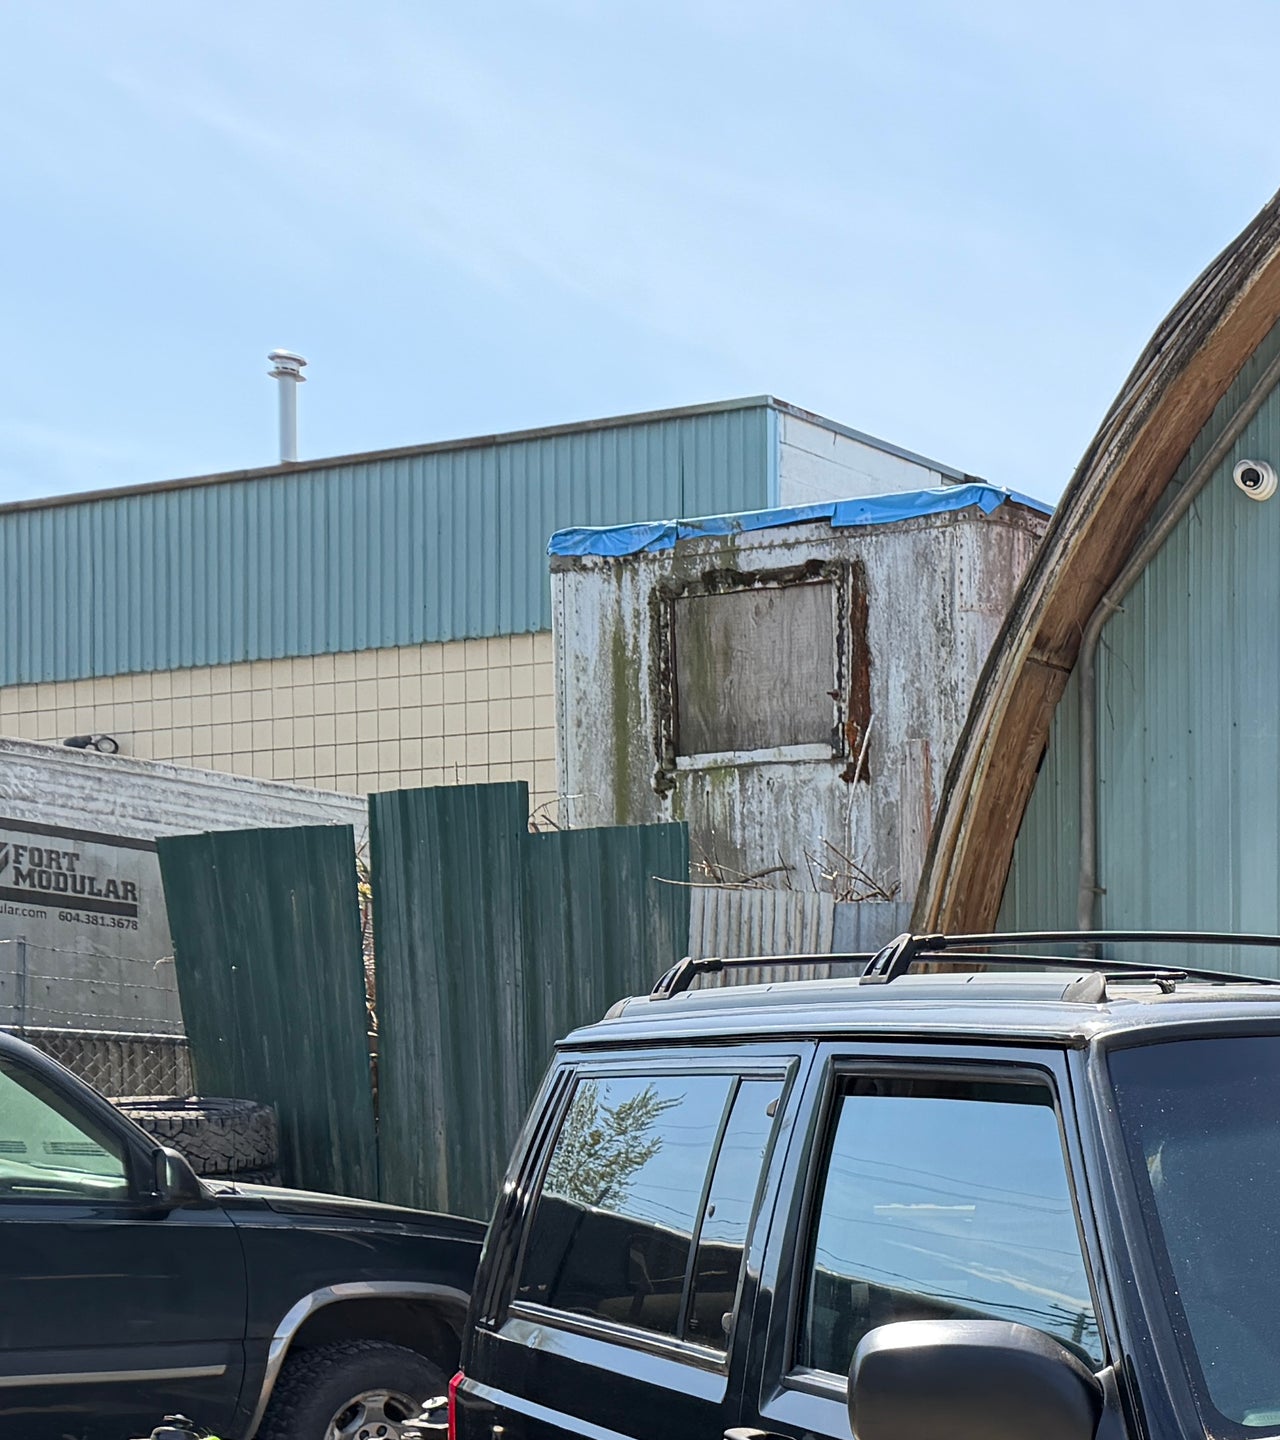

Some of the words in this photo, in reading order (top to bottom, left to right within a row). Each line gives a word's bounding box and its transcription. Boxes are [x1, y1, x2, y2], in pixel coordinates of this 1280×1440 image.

[11, 843, 80, 873] FORT
[12, 866, 138, 902] MODULAR
[58, 911, 139, 931] 604.381.3678
